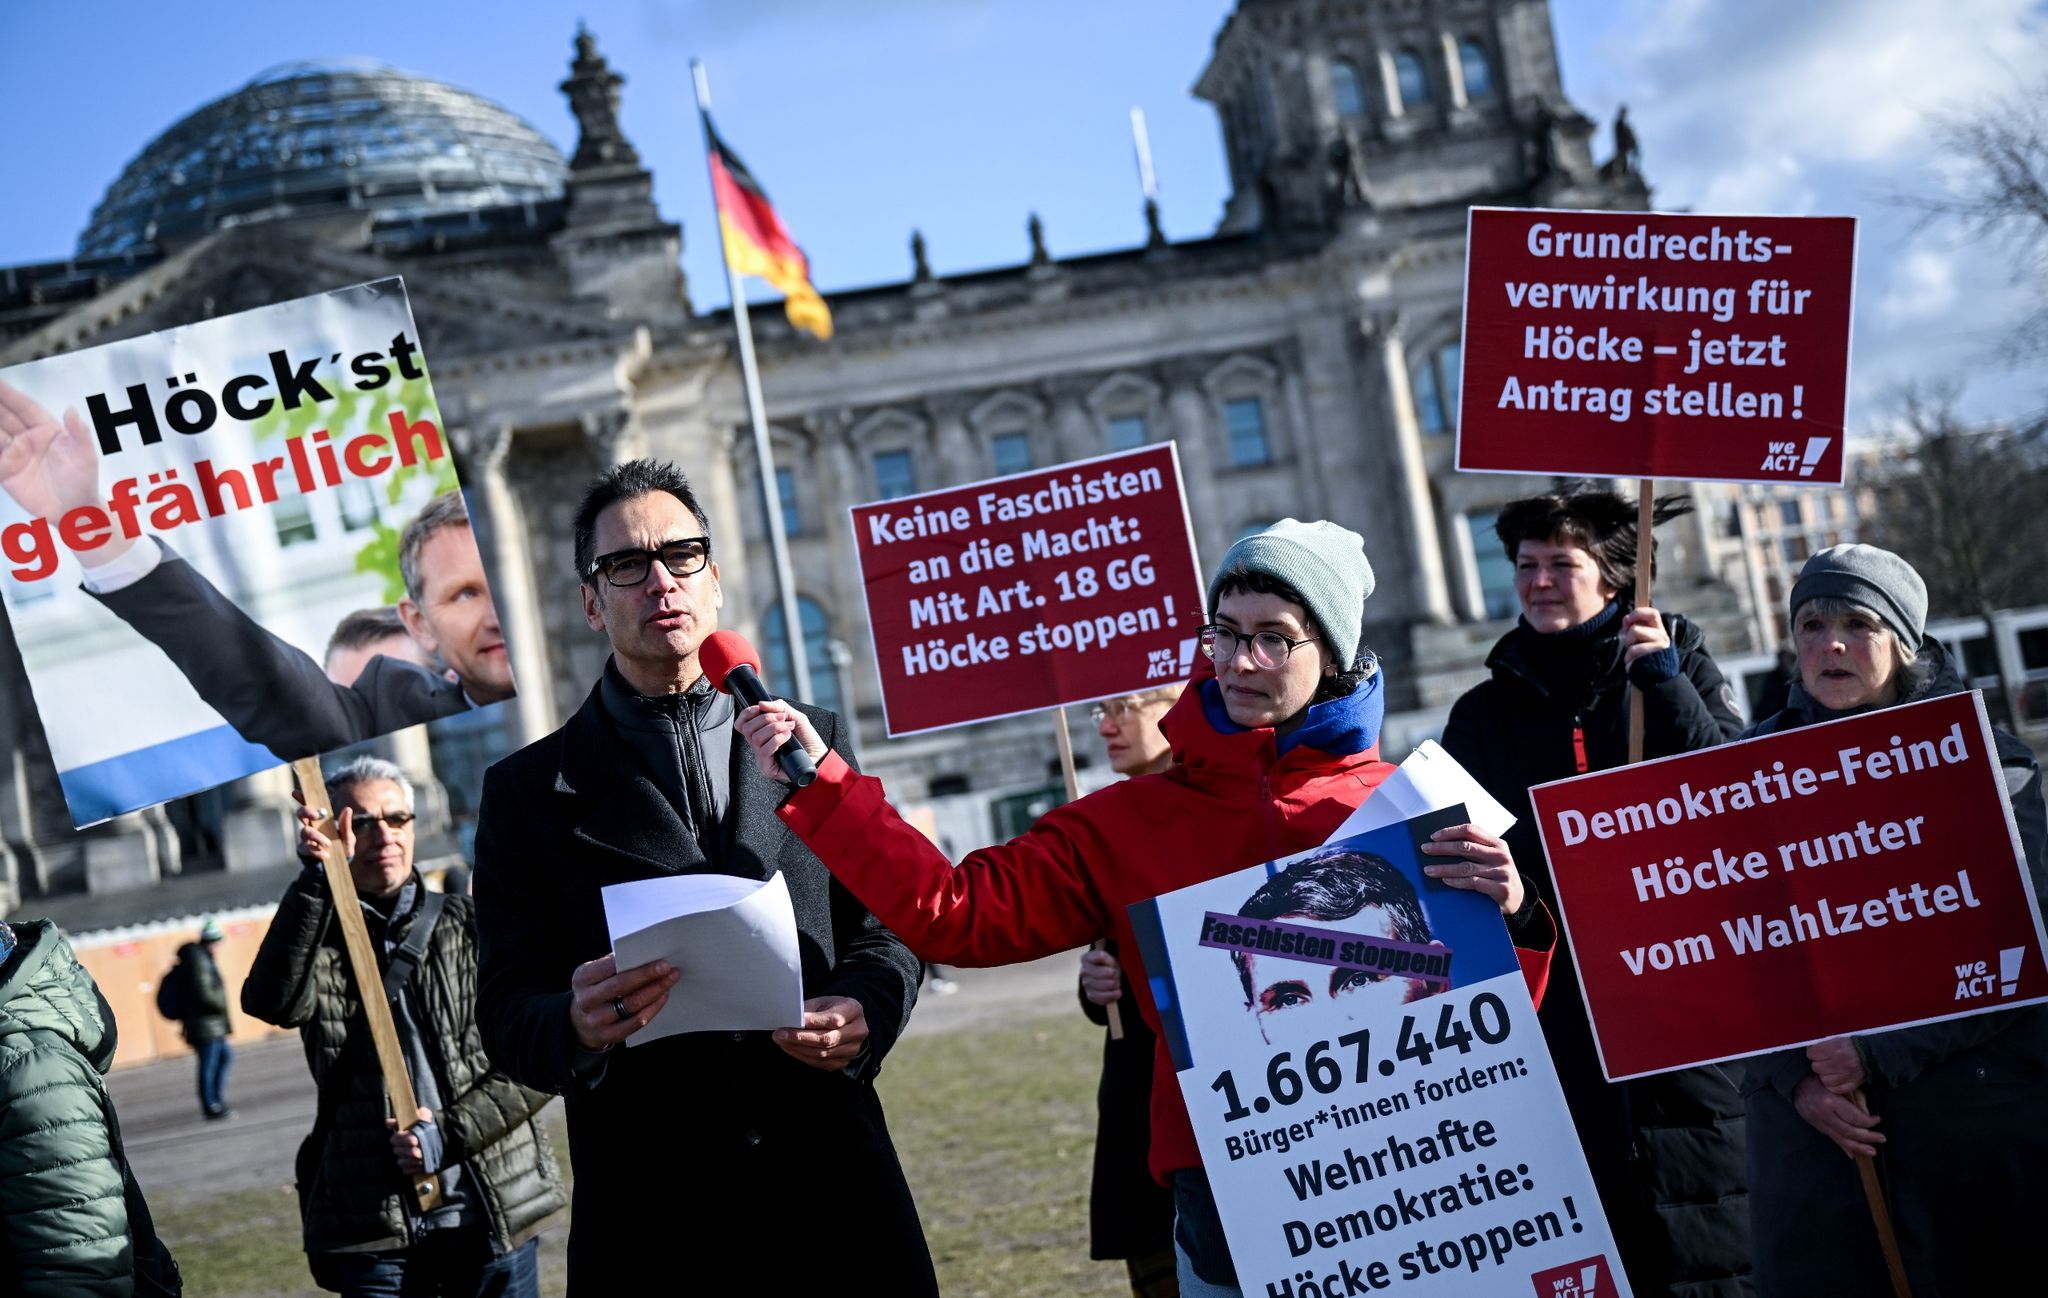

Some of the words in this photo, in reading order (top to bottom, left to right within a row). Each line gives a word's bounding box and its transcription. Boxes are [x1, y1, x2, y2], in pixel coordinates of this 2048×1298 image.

[1527, 223, 1792, 263] Grundrechts-
[1505, 274, 1736, 322] verwirkung
[1747, 279, 1811, 315] für
[1524, 325, 1643, 363] Höcke
[1684, 329, 1786, 374] jetzt
[1497, 376, 1632, 422] Antrag
[1768, 441, 1795, 455] we
[1, 411, 444, 582] gefährlich
[869, 505, 969, 545] Keine
[978, 467, 1162, 525] Faschisten
[909, 556, 951, 584] an
[960, 539, 1014, 574] die
[1022, 517, 1141, 562] Macht:
[909, 592, 968, 629] Mit
[976, 579, 1046, 617] Art.
[1055, 567, 1099, 601] 18
[1107, 554, 1155, 591] GG
[902, 633, 1010, 676] Höcke
[1148, 648, 1171, 663] we
[1557, 722, 1969, 846] Demokratie-Feind
[1631, 847, 1768, 902] Höcke
[1778, 815, 1925, 872] runter
[1200, 917, 1335, 959] Faschisten
[1619, 931, 1715, 976] vom
[1720, 869, 1980, 956] Wahlzettel
[1955, 960, 1987, 979] we
[1211, 991, 1512, 1123] 1.667.440
[1413, 1057, 1528, 1104] fordern:
[1283, 1118, 1498, 1202] Wehrhafte
[1282, 1163, 1534, 1258] Demokratie:
[1553, 1277, 1574, 1291] we
